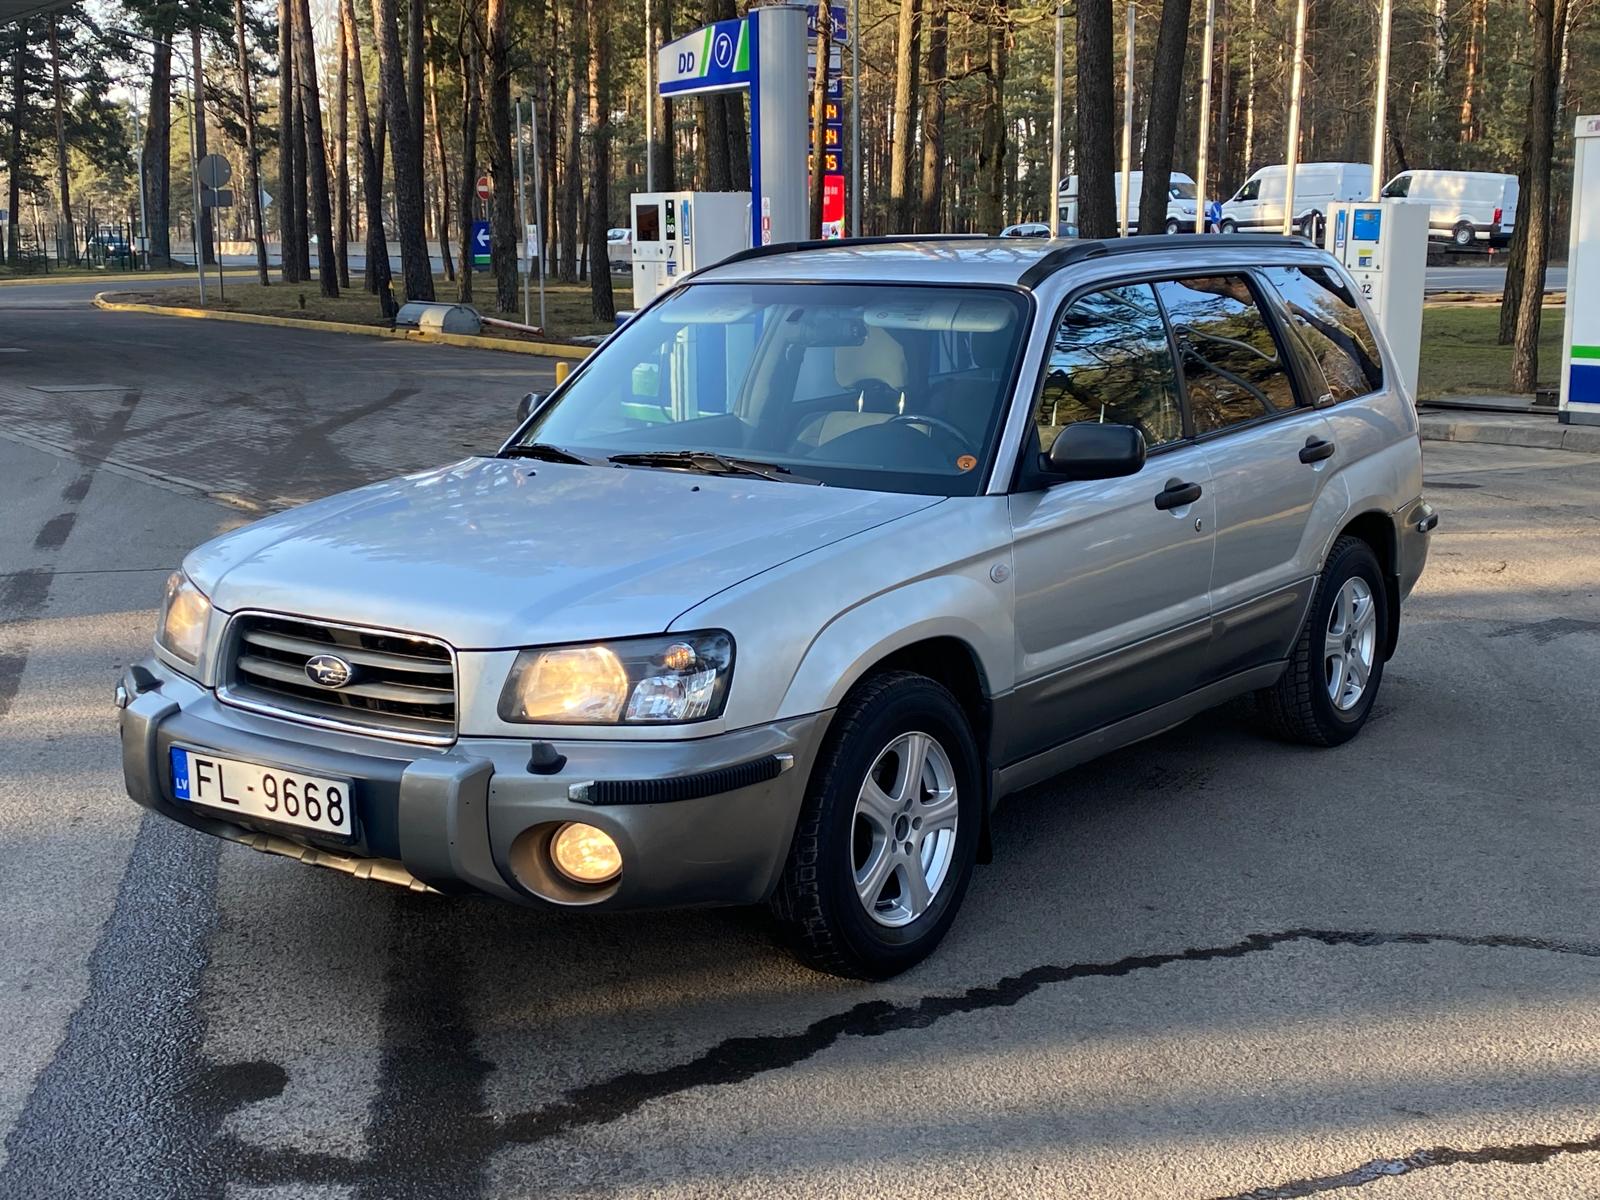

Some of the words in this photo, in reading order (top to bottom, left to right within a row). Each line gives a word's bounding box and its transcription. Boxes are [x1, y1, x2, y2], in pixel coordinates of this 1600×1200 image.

[678, 51, 695, 74] DD
[719, 40, 728, 61] 7
[668, 245, 674, 258] 7
[1362, 284, 1372, 293] 12
[176, 778, 188, 790] LV
[195, 759, 344, 826] FL-9668
